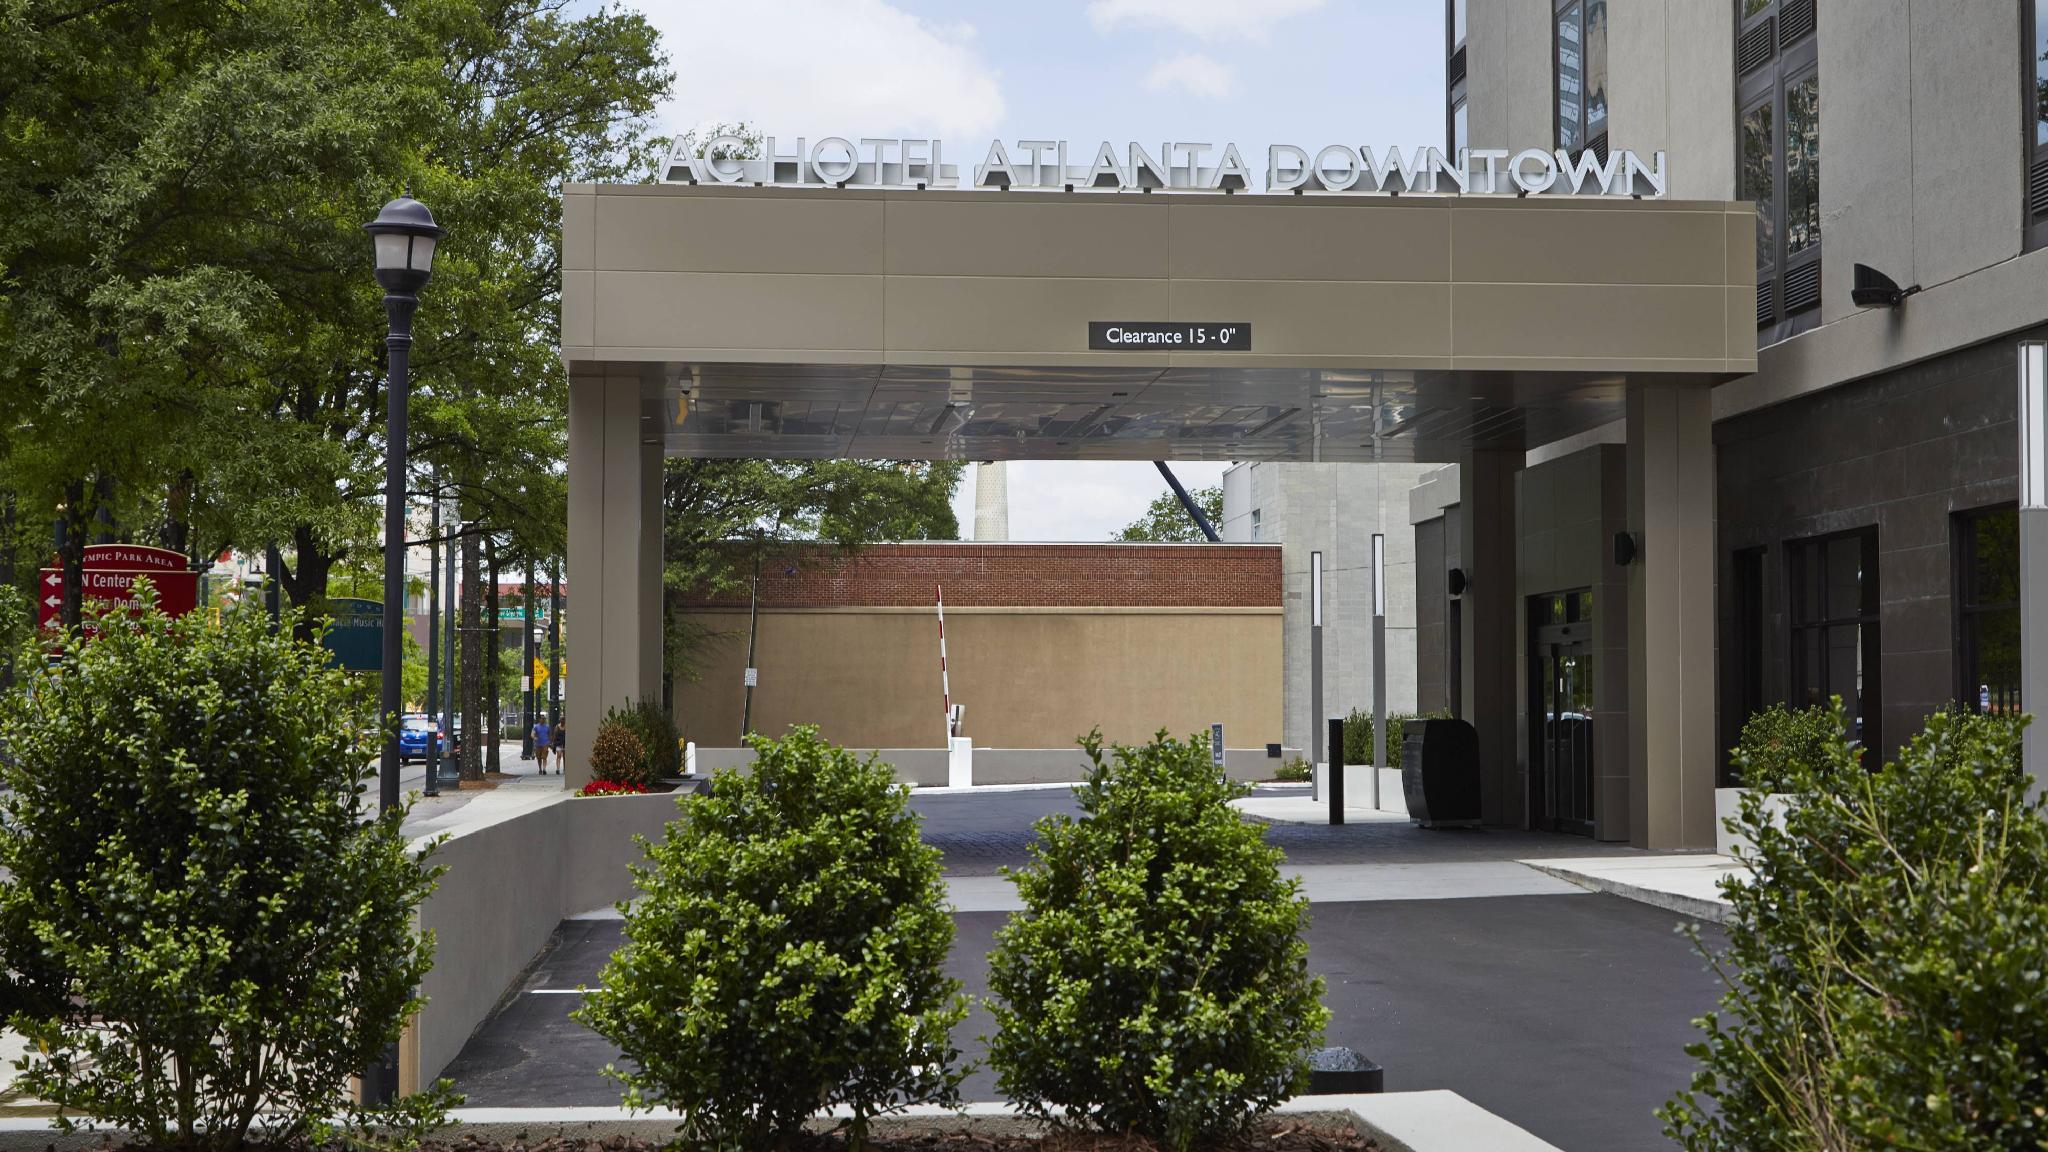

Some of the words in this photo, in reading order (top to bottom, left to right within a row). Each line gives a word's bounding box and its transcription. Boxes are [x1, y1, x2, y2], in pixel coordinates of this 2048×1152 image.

[659, 135, 744, 183] AC
[767, 137, 960, 186] HOTEL
[975, 139, 1252, 189] ATLANTA
[1268, 144, 1666, 197] DOWNTOWN
[1106, 327, 1183, 344] Clearance
[93, 573, 131, 588] Center
